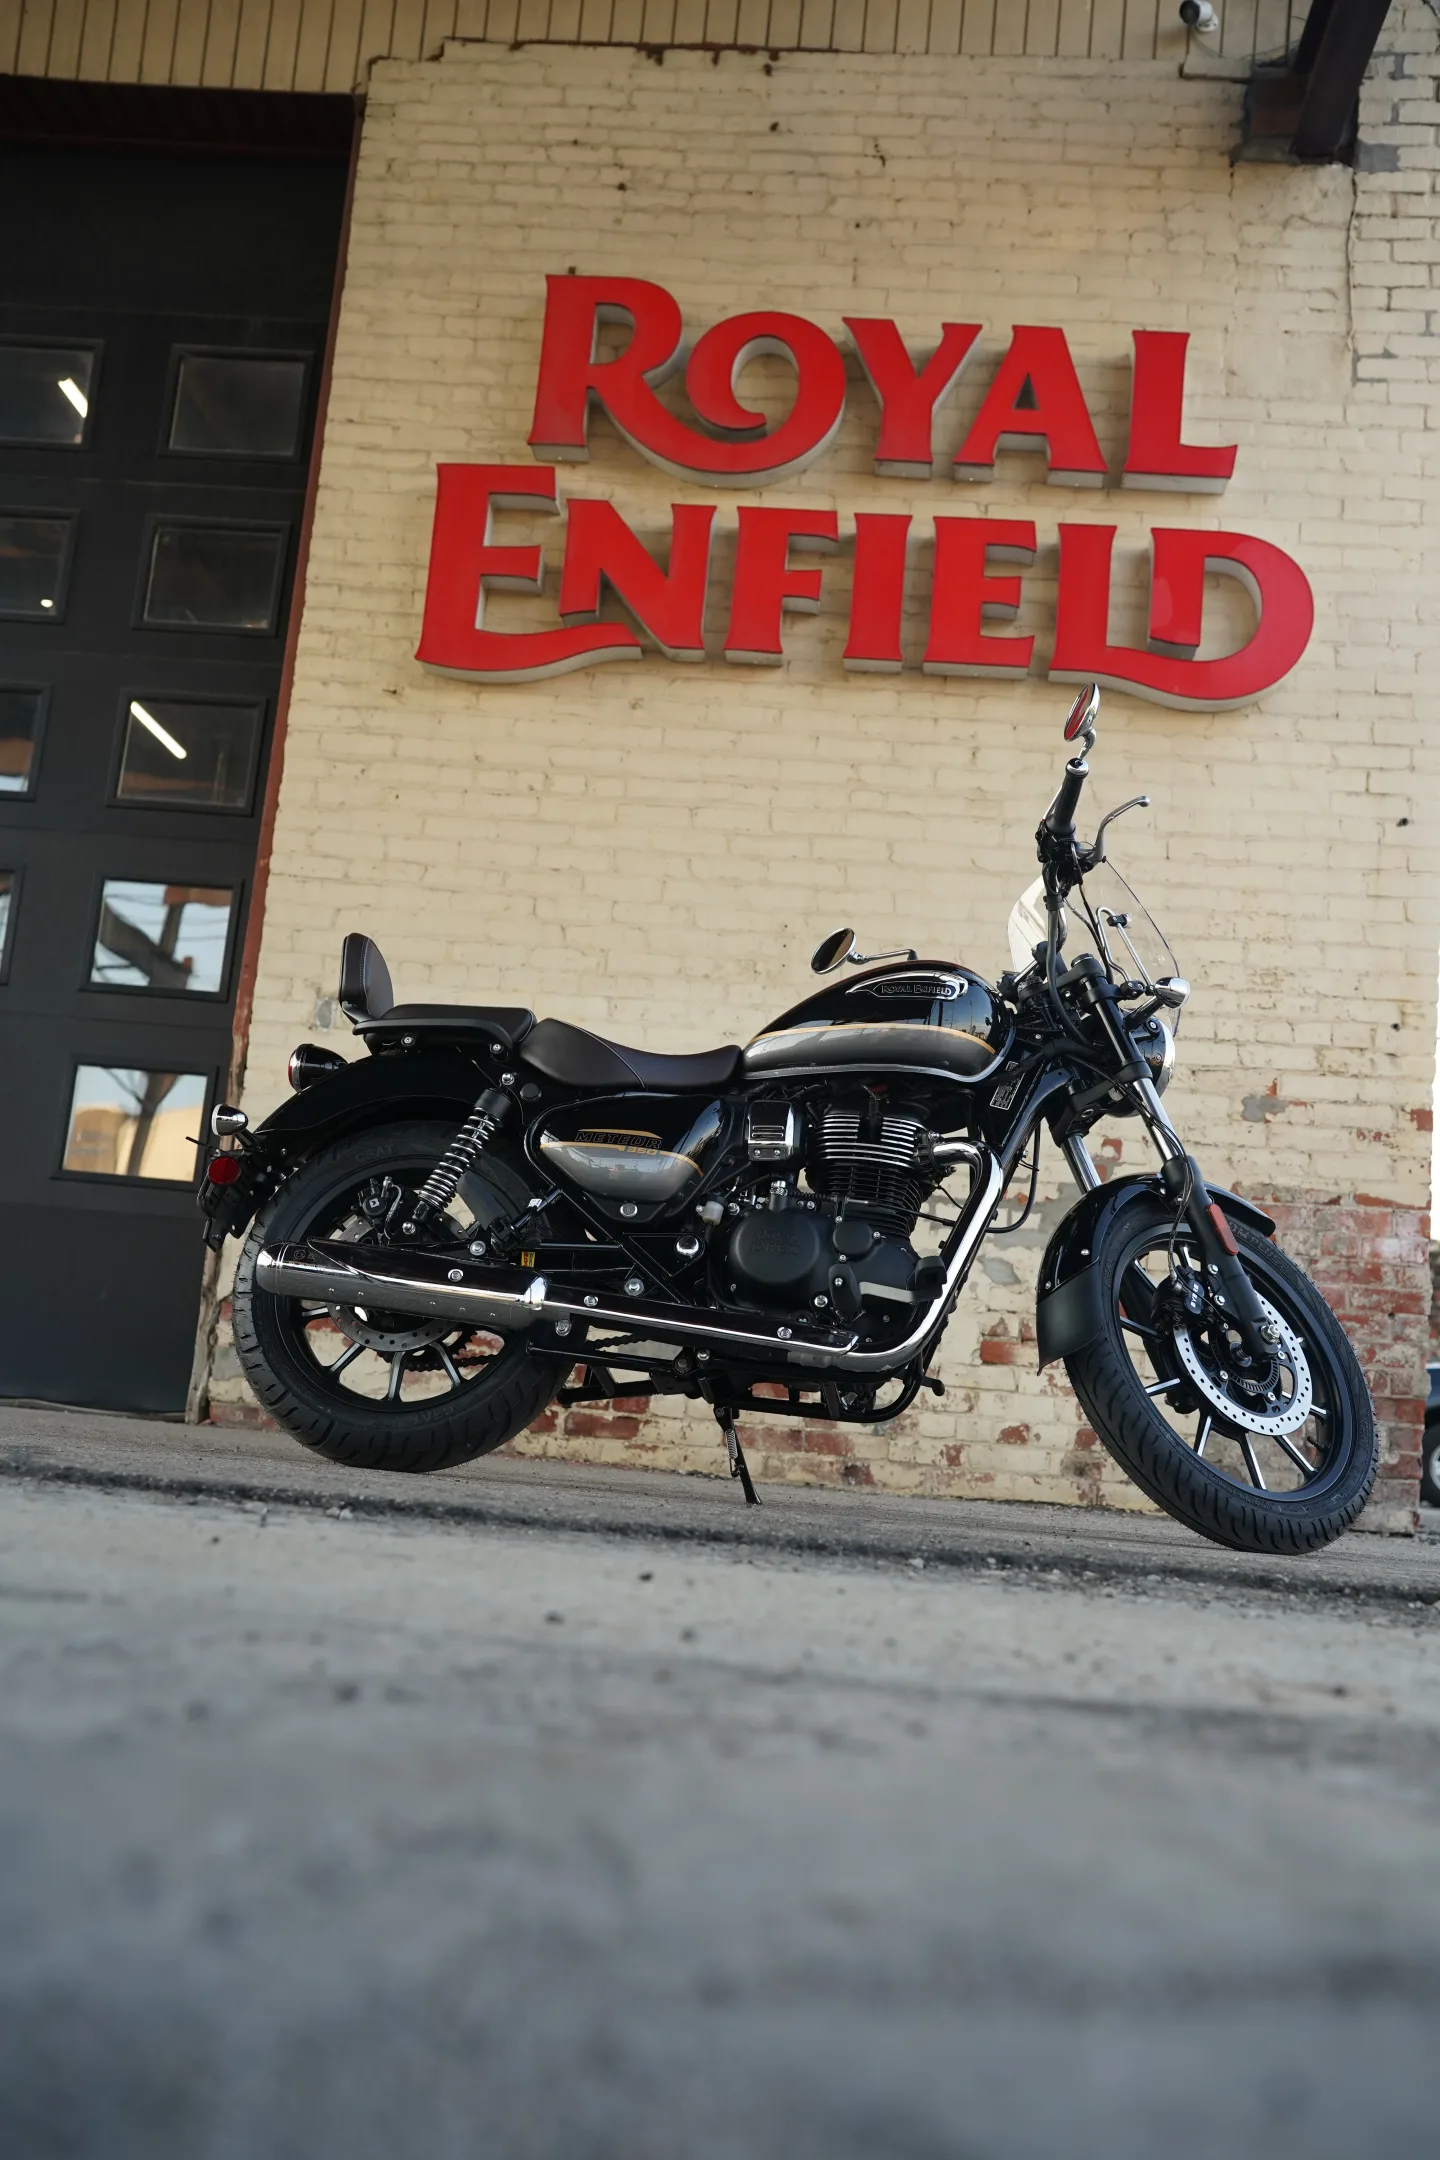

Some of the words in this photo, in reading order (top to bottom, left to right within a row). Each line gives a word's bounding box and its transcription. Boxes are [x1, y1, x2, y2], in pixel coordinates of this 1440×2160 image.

[527, 274, 1238, 493] ROYAL
[415, 462, 1314, 712] ENFIELD
[881, 984, 912, 994] ROYAL
[913, 984, 952, 996] ENFIELD
[574, 1131, 662, 1149] METEOR
